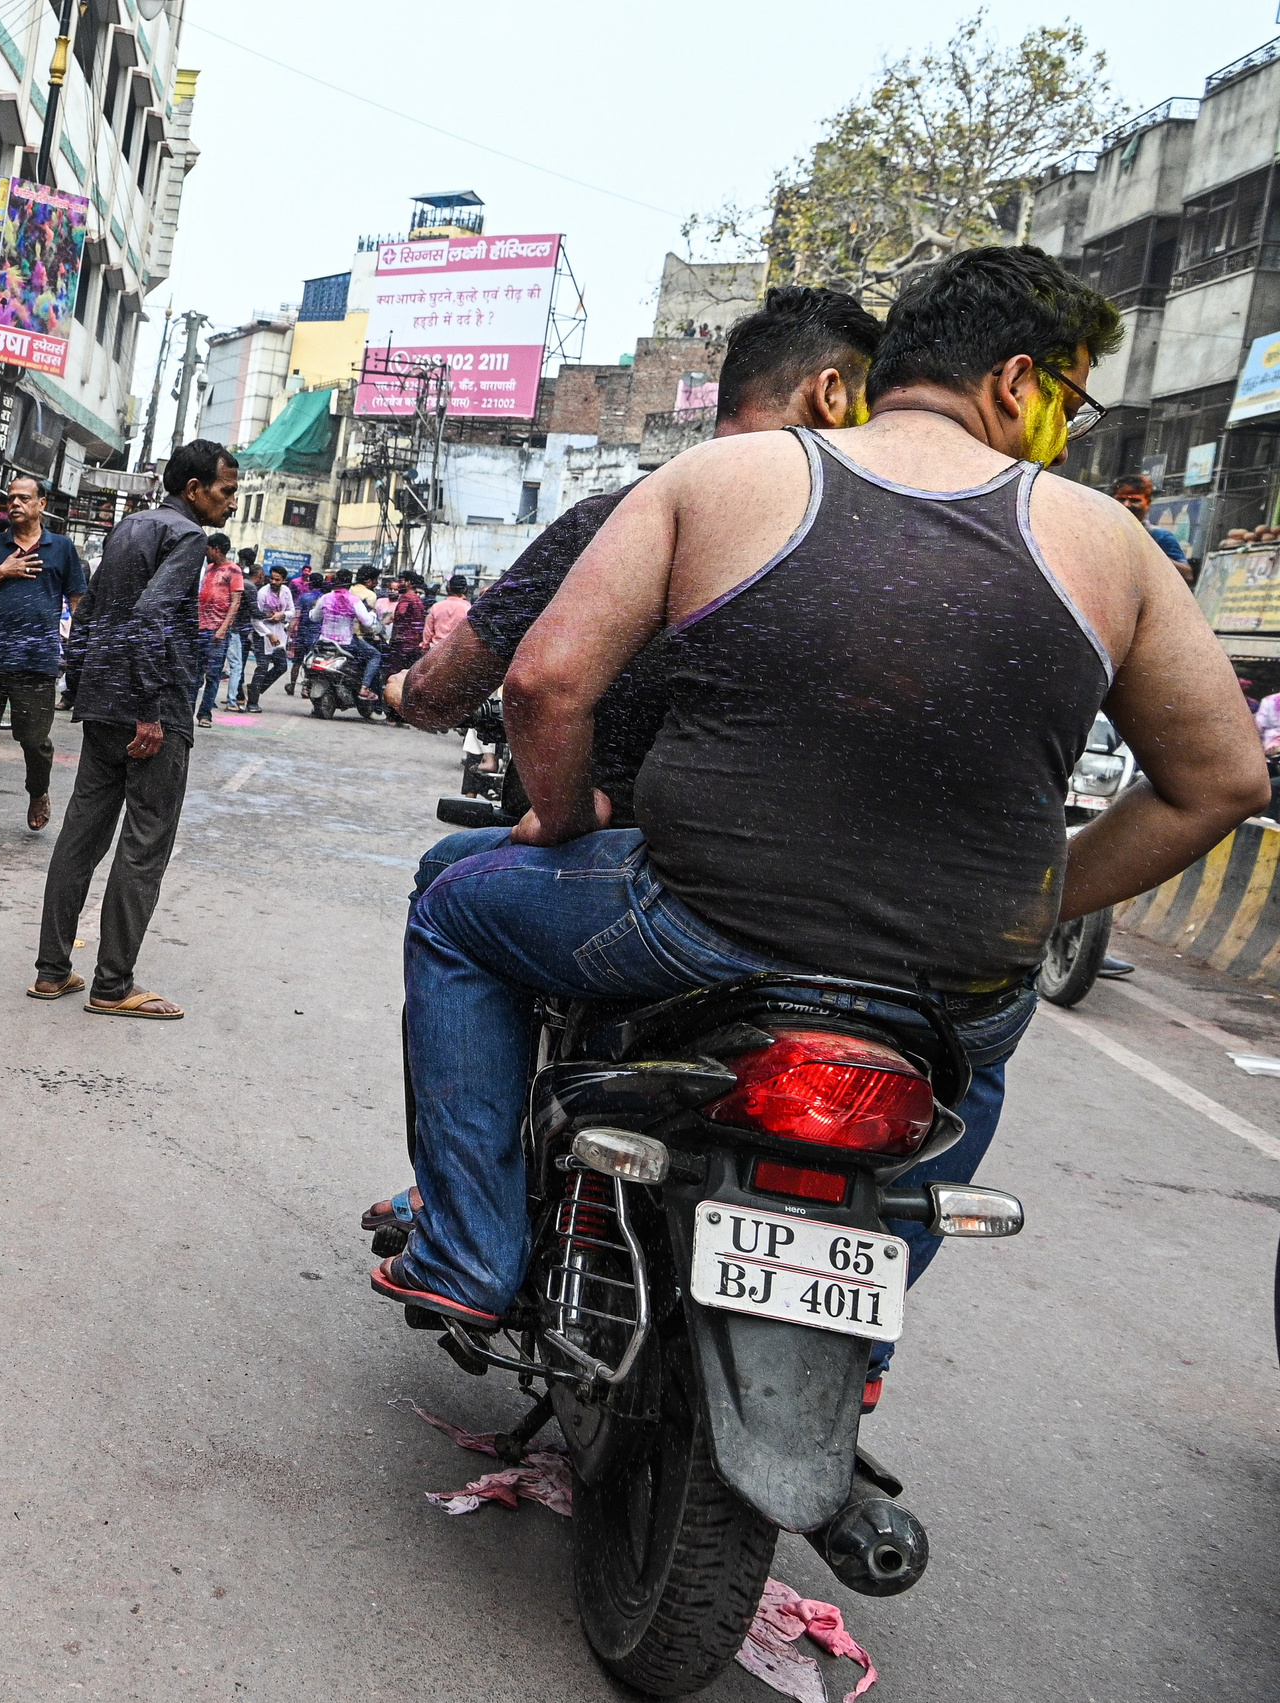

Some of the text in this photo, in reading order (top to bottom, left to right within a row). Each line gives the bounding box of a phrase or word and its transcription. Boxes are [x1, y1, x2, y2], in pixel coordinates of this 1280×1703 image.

[400, 239, 553, 263] सिग्नस लक्ष्मी हॉस्पिटल
[377, 294, 395, 304] क्या
[396, 289, 426, 304] आपके
[527, 284, 542, 299] की
[443, 312, 452, 326] में
[476, 308, 484, 327] है
[478, 353, 509, 371] 2111
[480, 378, 517, 391] वाराणसी
[481, 398, 516, 409] 221002
[784, 1205, 806, 1215] Hero
[729, 1215, 875, 1275] UP 65
[715, 1260, 883, 1327] BJ 4011
